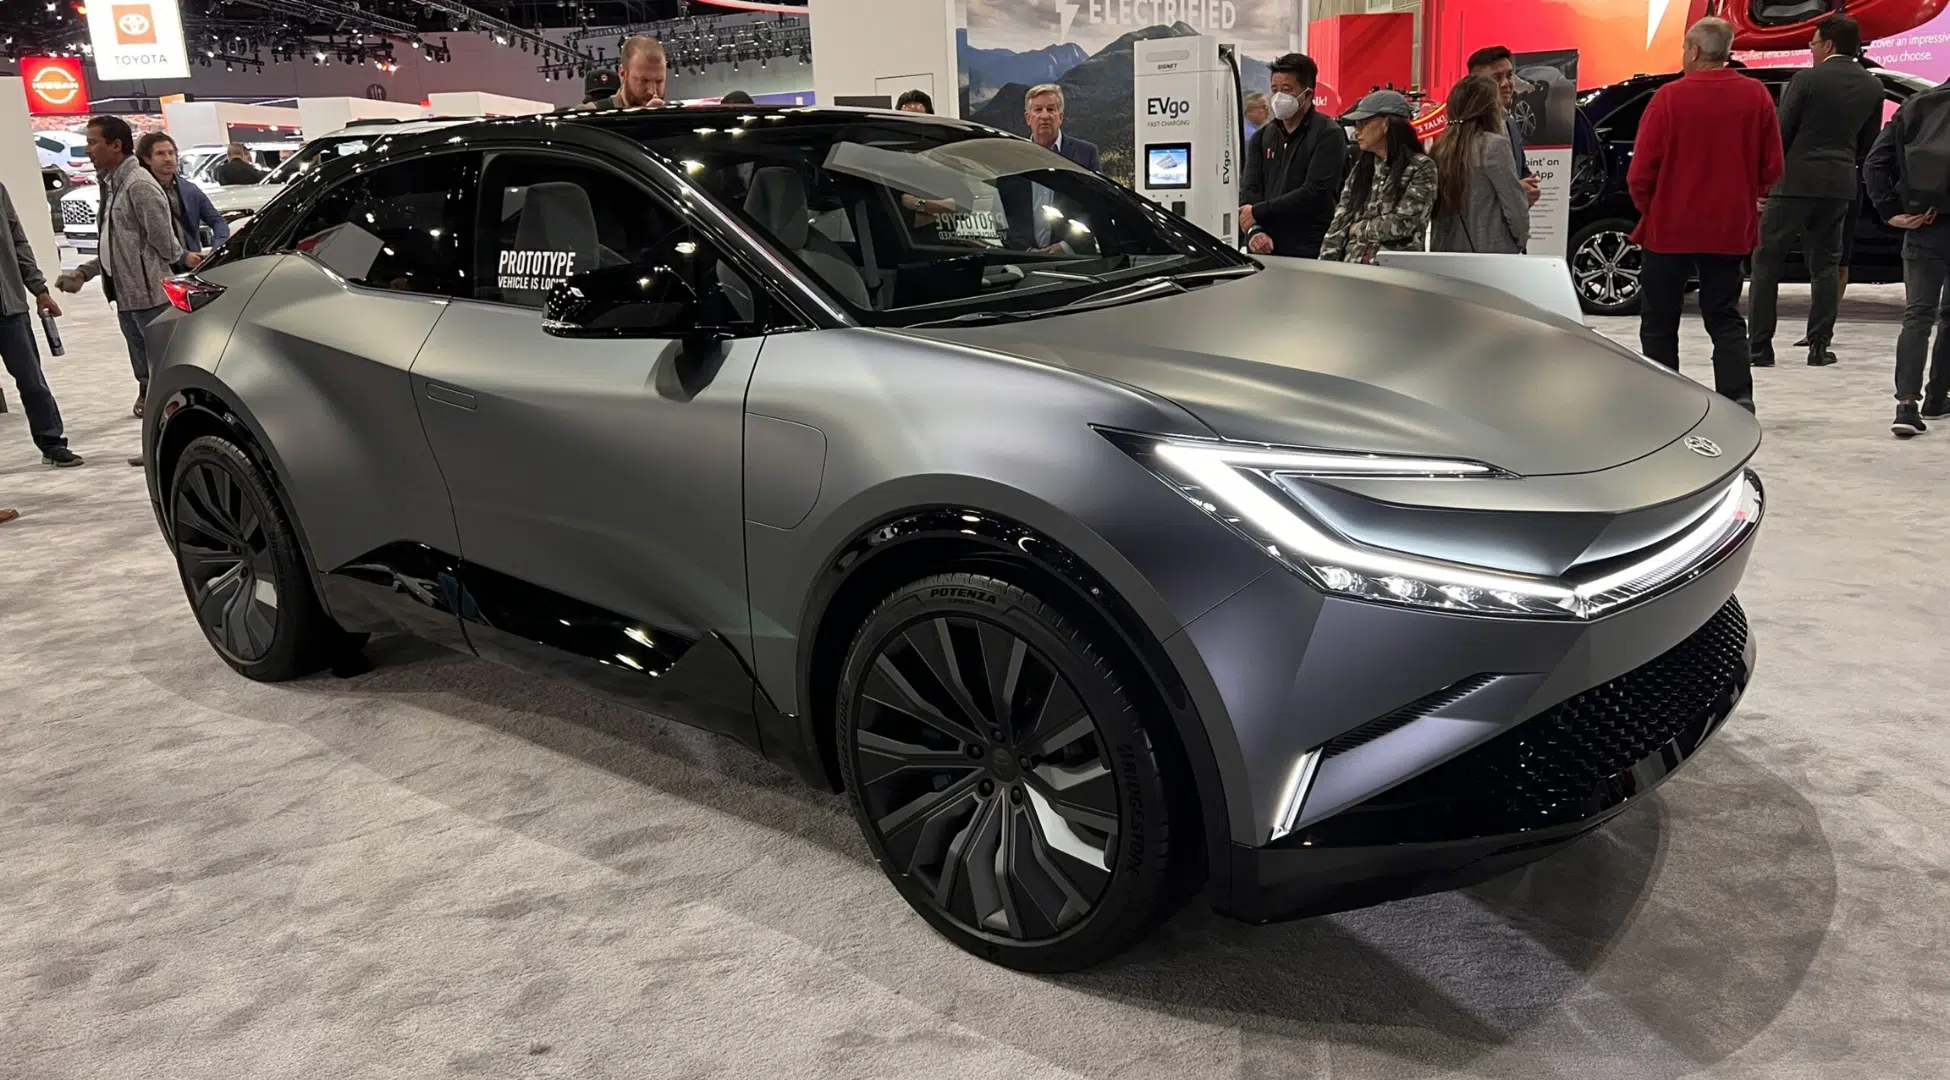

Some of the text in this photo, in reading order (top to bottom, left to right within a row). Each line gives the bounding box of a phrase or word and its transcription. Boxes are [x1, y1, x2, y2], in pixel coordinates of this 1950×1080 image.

[1089, 0, 1237, 29] ELECTRIFIED
[1870, 32, 1950, 48] cover an impressiv
[114, 54, 168, 65] TOYOTA
[1882, 54, 1898, 67] you
[1900, 50, 1933, 62] choose.
[1147, 96, 1190, 119] EVgo
[1161, 119, 1190, 127] CHARGING
[1423, 114, 1446, 131] TALK!
[1222, 150, 1231, 184] EVgo
[1536, 170, 1554, 180] App
[498, 250, 576, 276] PROTOTYPE
[498, 276, 529, 289] VEHICLE
[530, 277, 539, 289] IS
[930, 587, 997, 605] POTENZA
